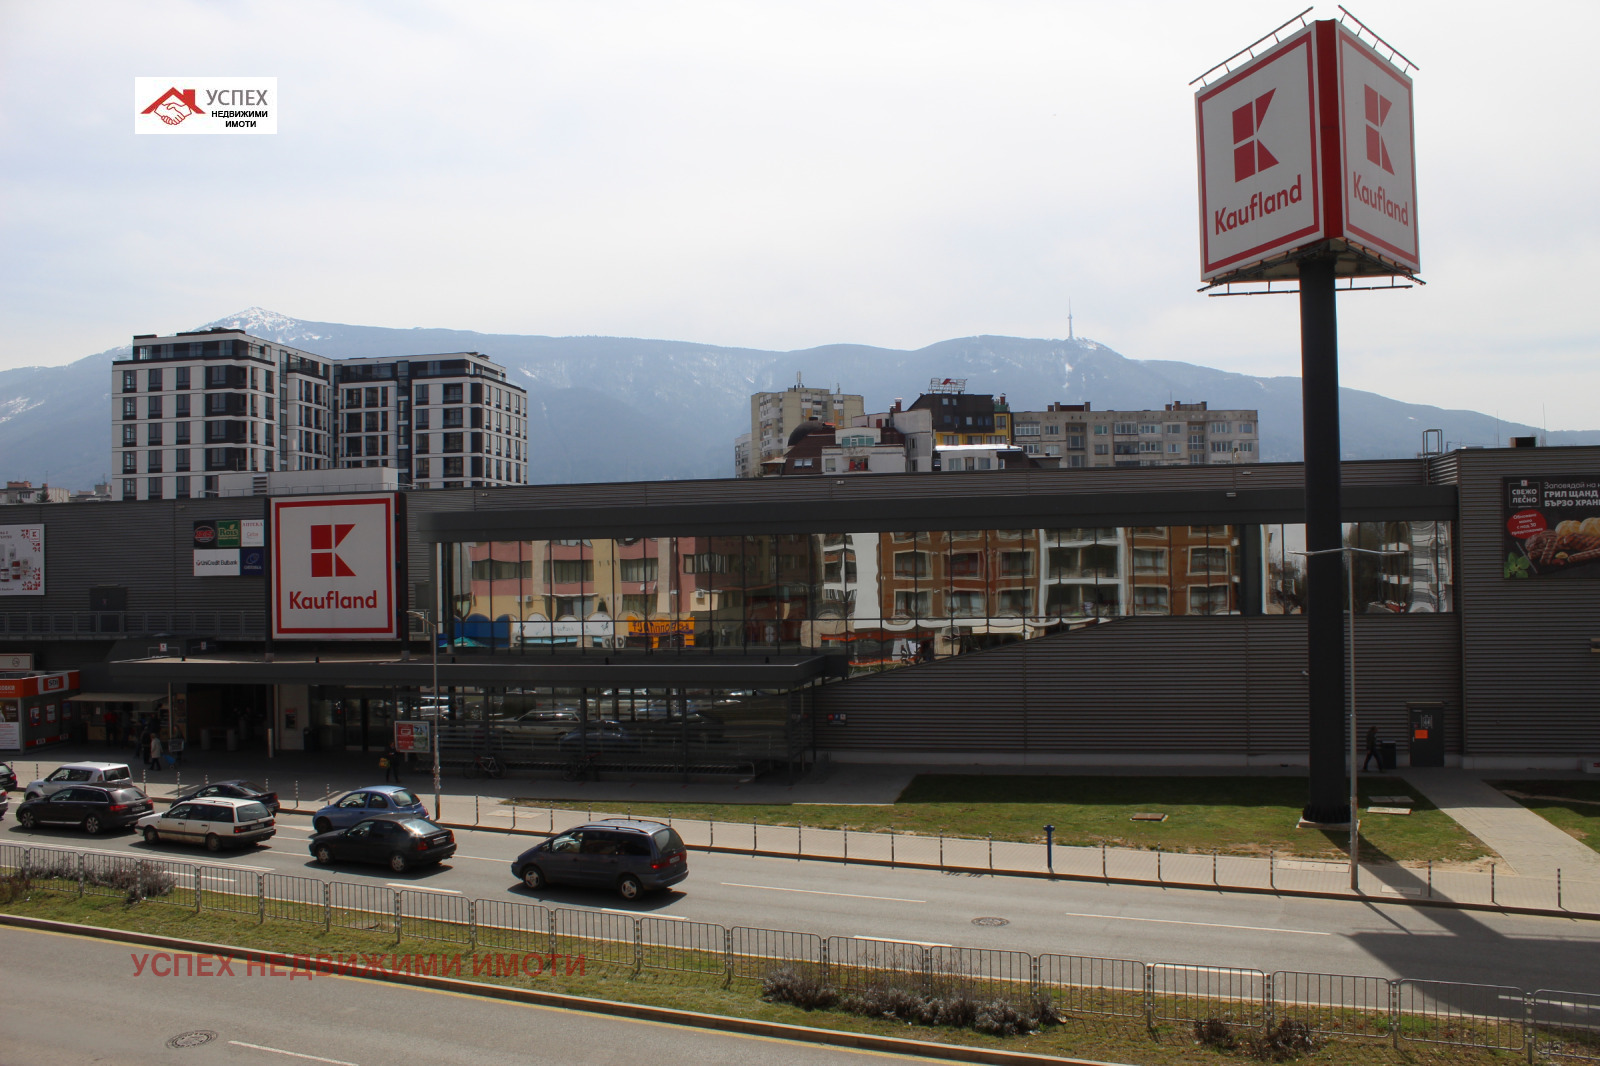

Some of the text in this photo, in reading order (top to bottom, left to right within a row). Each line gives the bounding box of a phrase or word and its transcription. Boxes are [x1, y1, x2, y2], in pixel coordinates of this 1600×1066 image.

[1214, 173, 1303, 235] Kaufland
[1353, 171, 1408, 227] Kaufland
[1544, 490, 1599, 498] ГРИЛ ЩАНД
[1544, 499, 1573, 507] БЪРЗО
[289, 589, 378, 611] Kaufland
